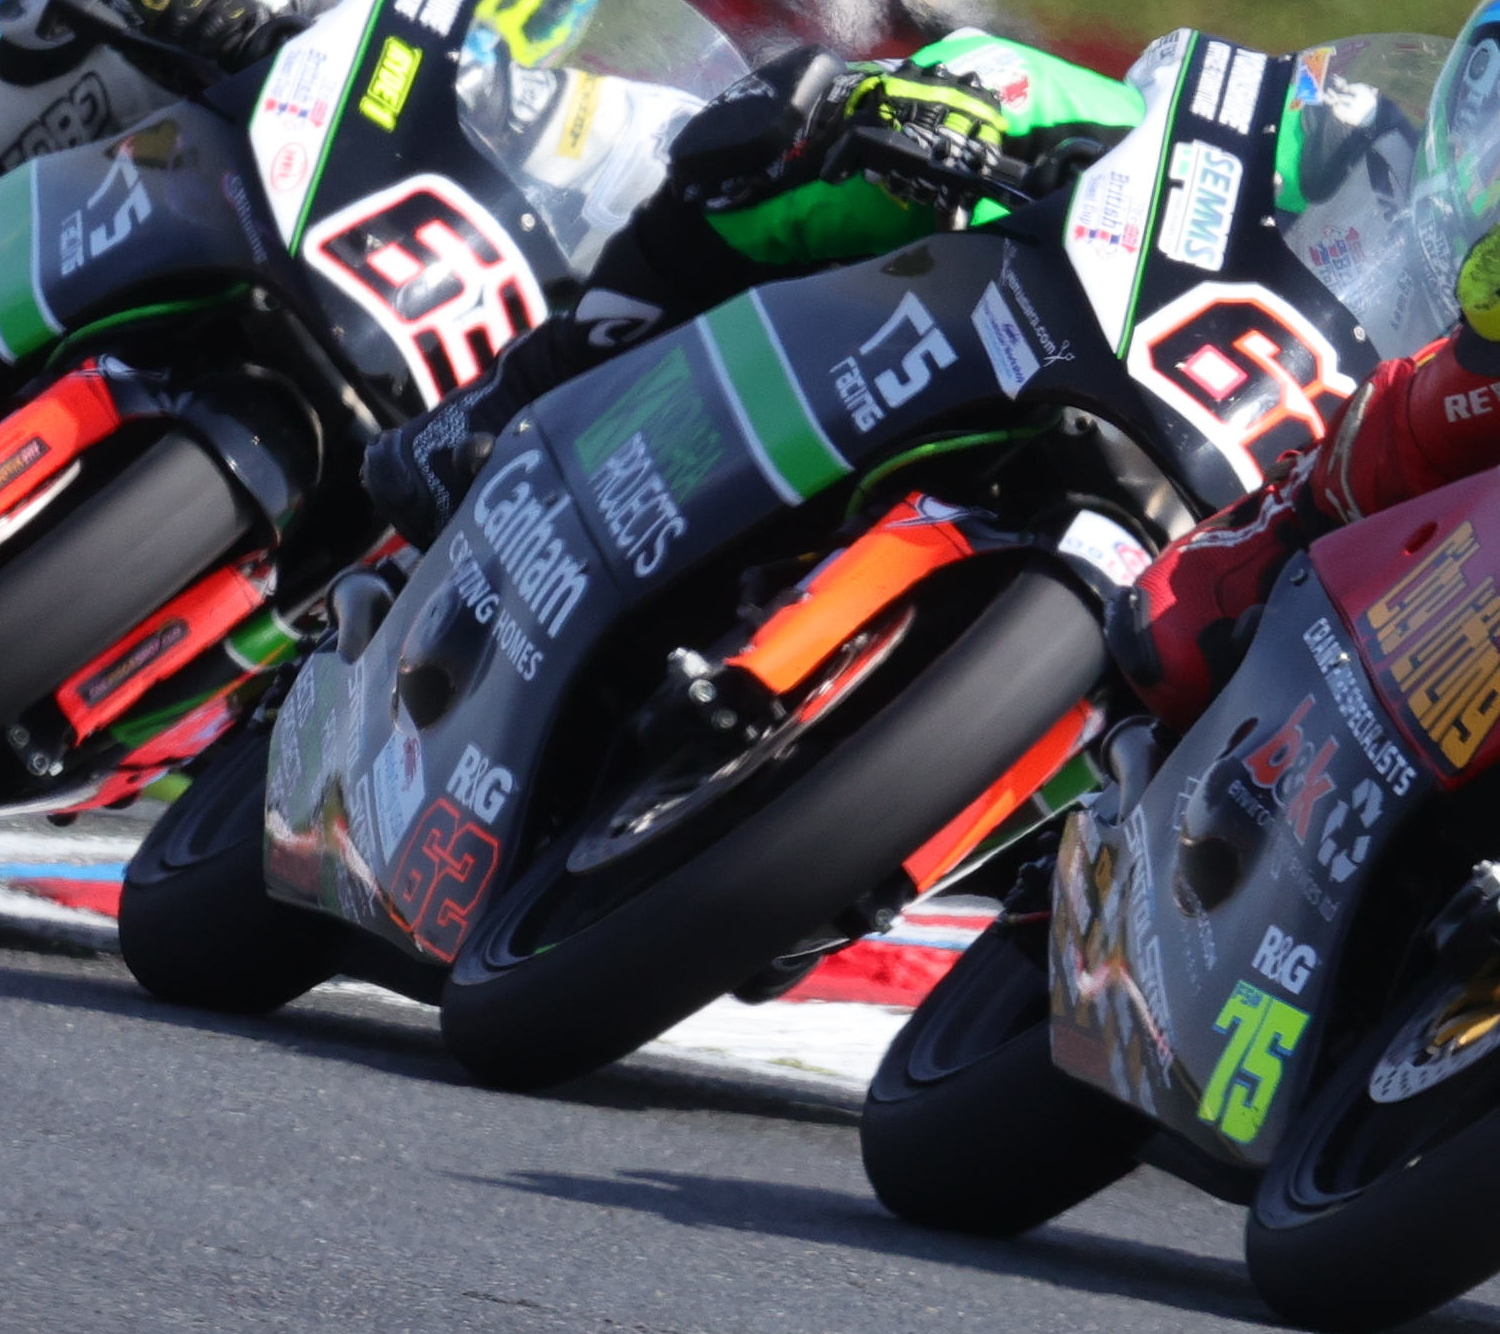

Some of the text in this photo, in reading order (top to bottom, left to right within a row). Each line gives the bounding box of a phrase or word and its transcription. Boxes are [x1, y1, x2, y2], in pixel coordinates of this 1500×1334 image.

[1100, 170, 1130, 228] British
[1184, 150, 1236, 267] SEMMS
[830, 357, 886, 437] racing
[473, 449, 588, 639] Canham
[587, 431, 687, 578] PROJECTS
[1367, 520, 1481, 656] City
[491, 609, 544, 682] HOMES
[447, 744, 514, 825] R&G
[1338, 691, 1418, 798] SPECIALISTS
[390, 797, 500, 964] 62
[1252, 924, 1318, 996] R&G
[1197, 979, 1310, 1145] 75
